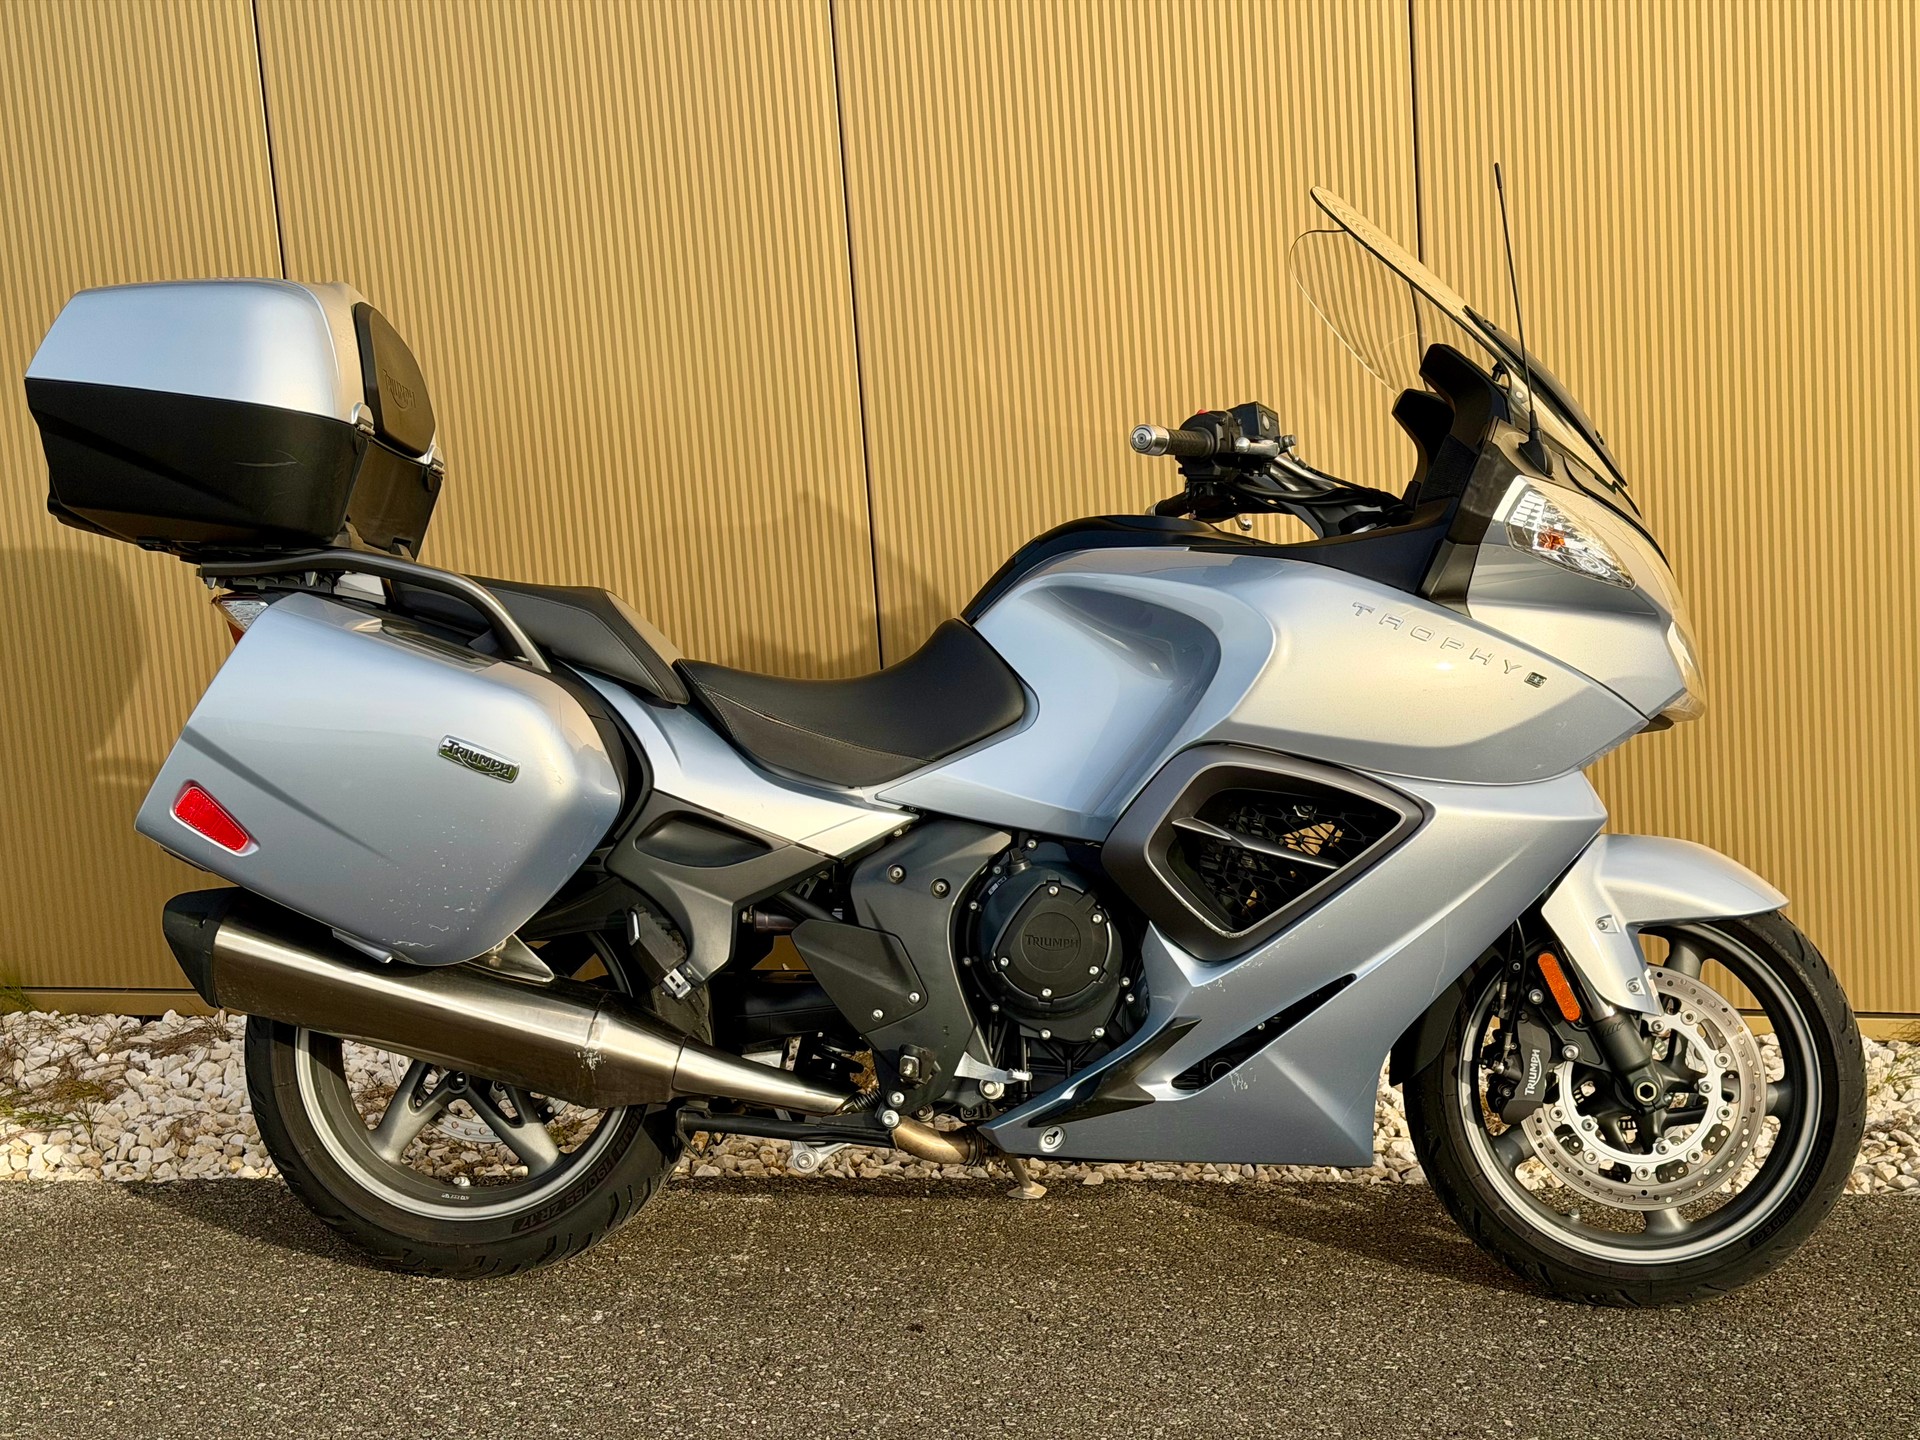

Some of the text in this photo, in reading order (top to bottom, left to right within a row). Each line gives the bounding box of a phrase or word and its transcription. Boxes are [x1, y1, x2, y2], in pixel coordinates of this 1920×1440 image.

[1352, 601, 1522, 675] TROPHY
[443, 739, 514, 777] TRIUMPH
[1025, 934, 1079, 951] TRIUMPH
[1524, 1049, 1542, 1095] TRIUMPH
